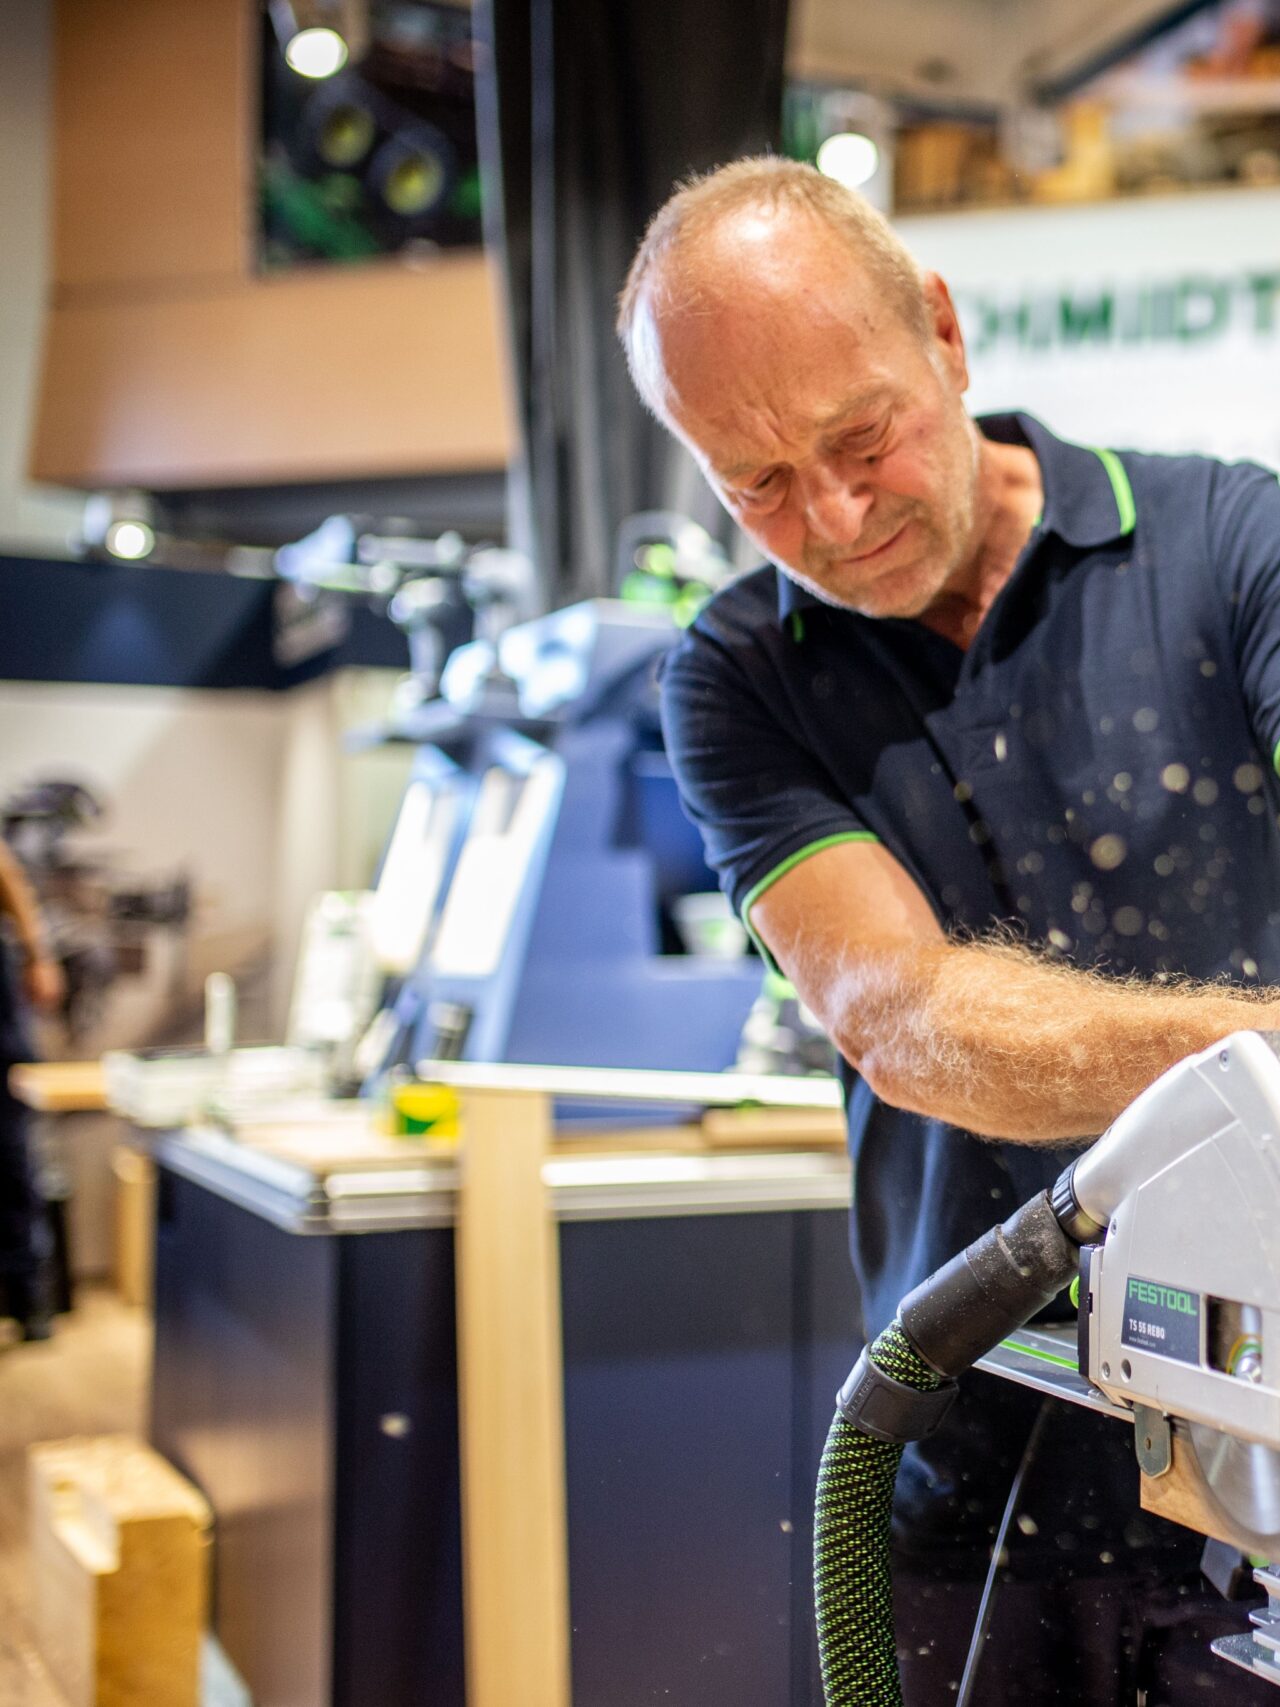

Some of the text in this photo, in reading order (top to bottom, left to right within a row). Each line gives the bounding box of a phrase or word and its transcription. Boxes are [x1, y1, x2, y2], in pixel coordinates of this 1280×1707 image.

[1128, 1279, 1198, 1316] FESTOOL
[1128, 1318, 1138, 1332] TS
[1138, 1321, 1147, 1335] 55
